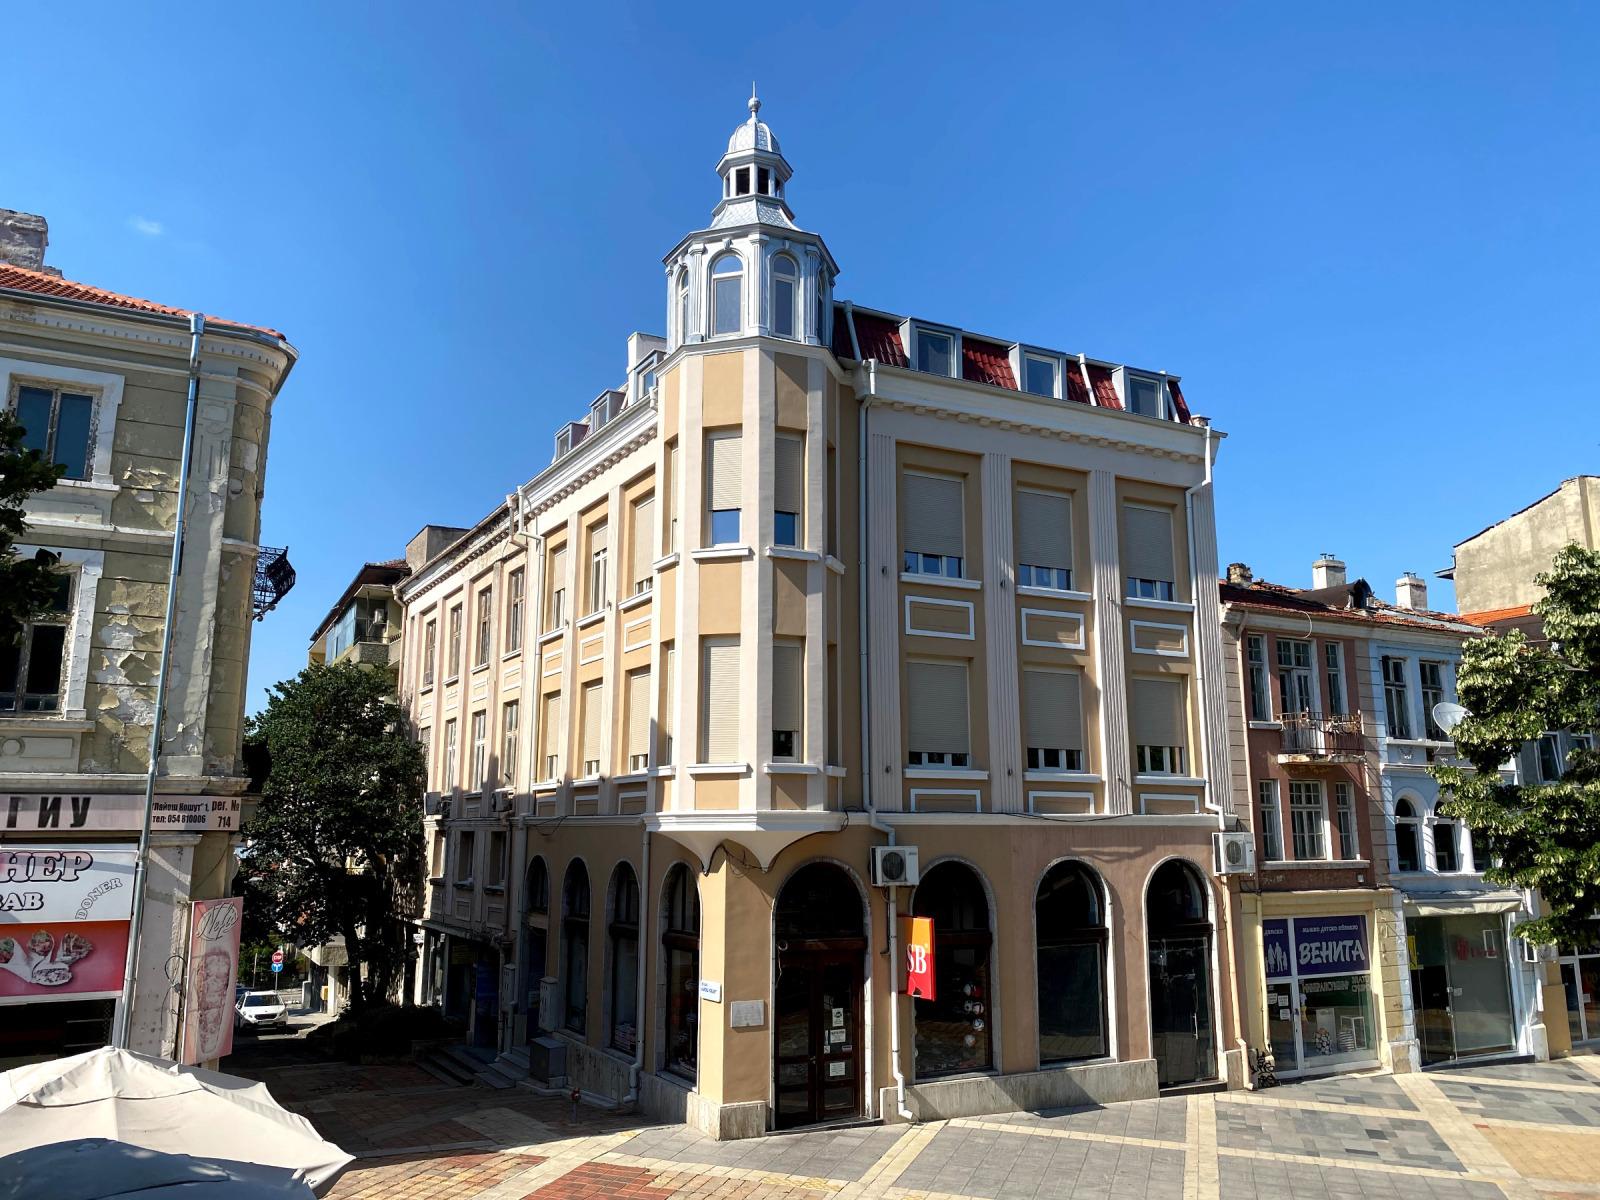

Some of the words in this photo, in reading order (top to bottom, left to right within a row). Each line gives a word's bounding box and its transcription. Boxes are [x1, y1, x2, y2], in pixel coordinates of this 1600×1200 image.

[217, 816, 232, 828] 714
[75, 878, 123, 920] DONER
[1299, 940, 1366, 965] ВЕНИТА
